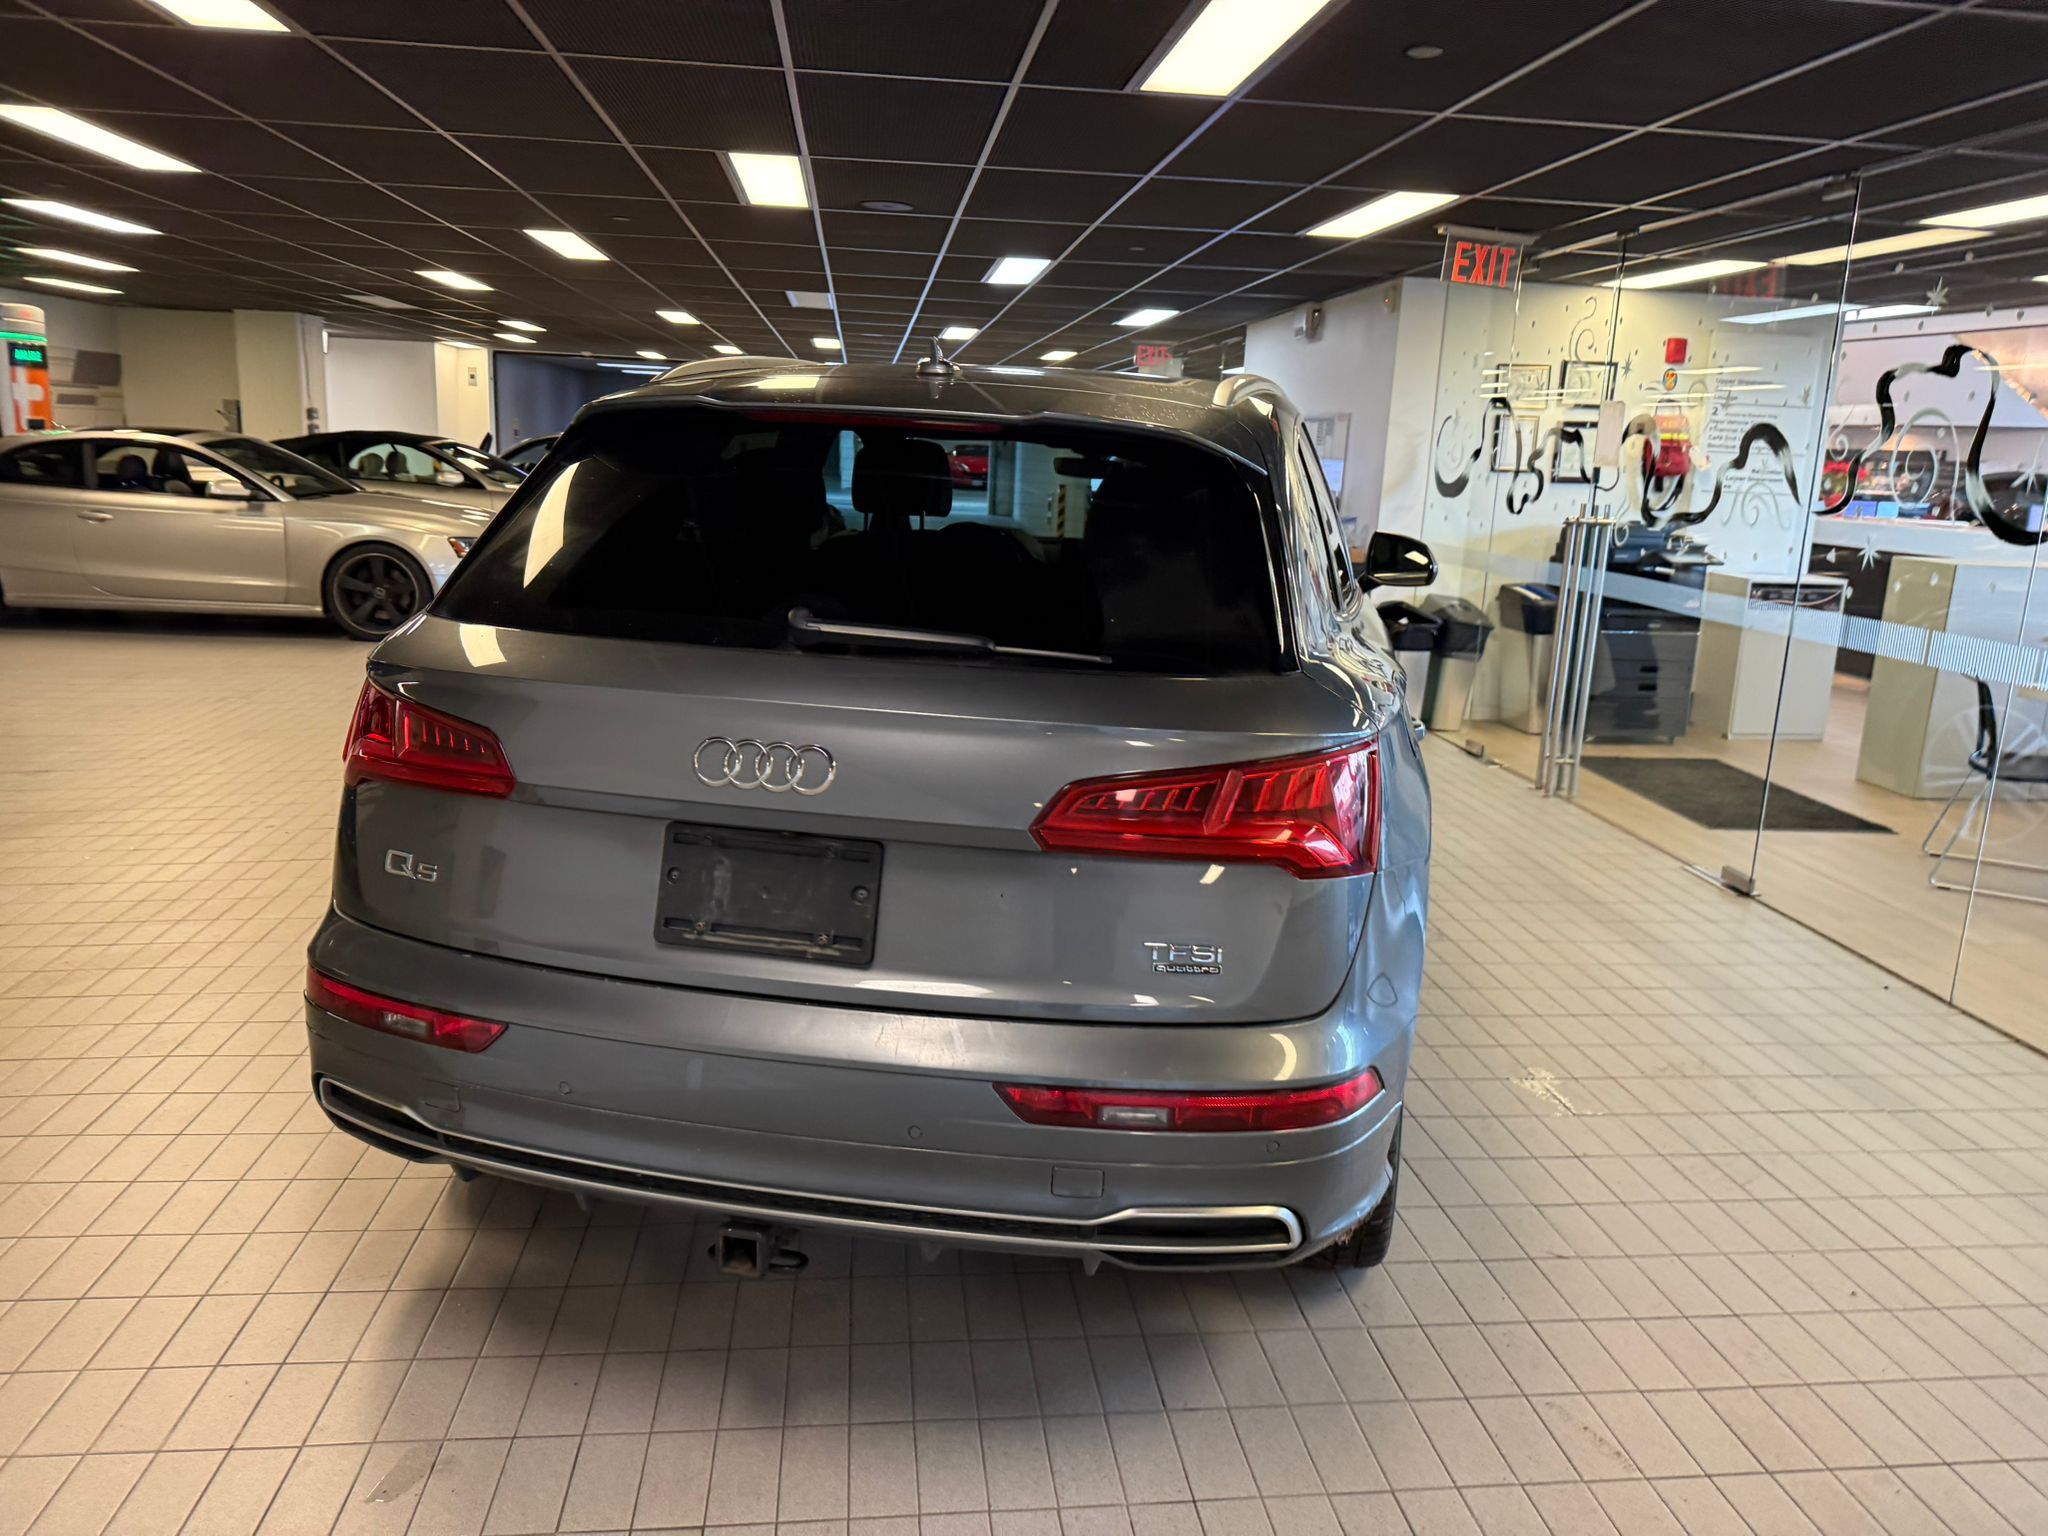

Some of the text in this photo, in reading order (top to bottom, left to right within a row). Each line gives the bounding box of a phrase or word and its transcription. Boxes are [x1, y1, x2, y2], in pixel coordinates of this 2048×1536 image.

[1450, 241, 1517, 288] EXIT
[1136, 344, 1169, 368] EXIT
[1711, 406, 1719, 416] 2
[385, 849, 437, 882] Q5
[1155, 964, 1220, 974] quattro
